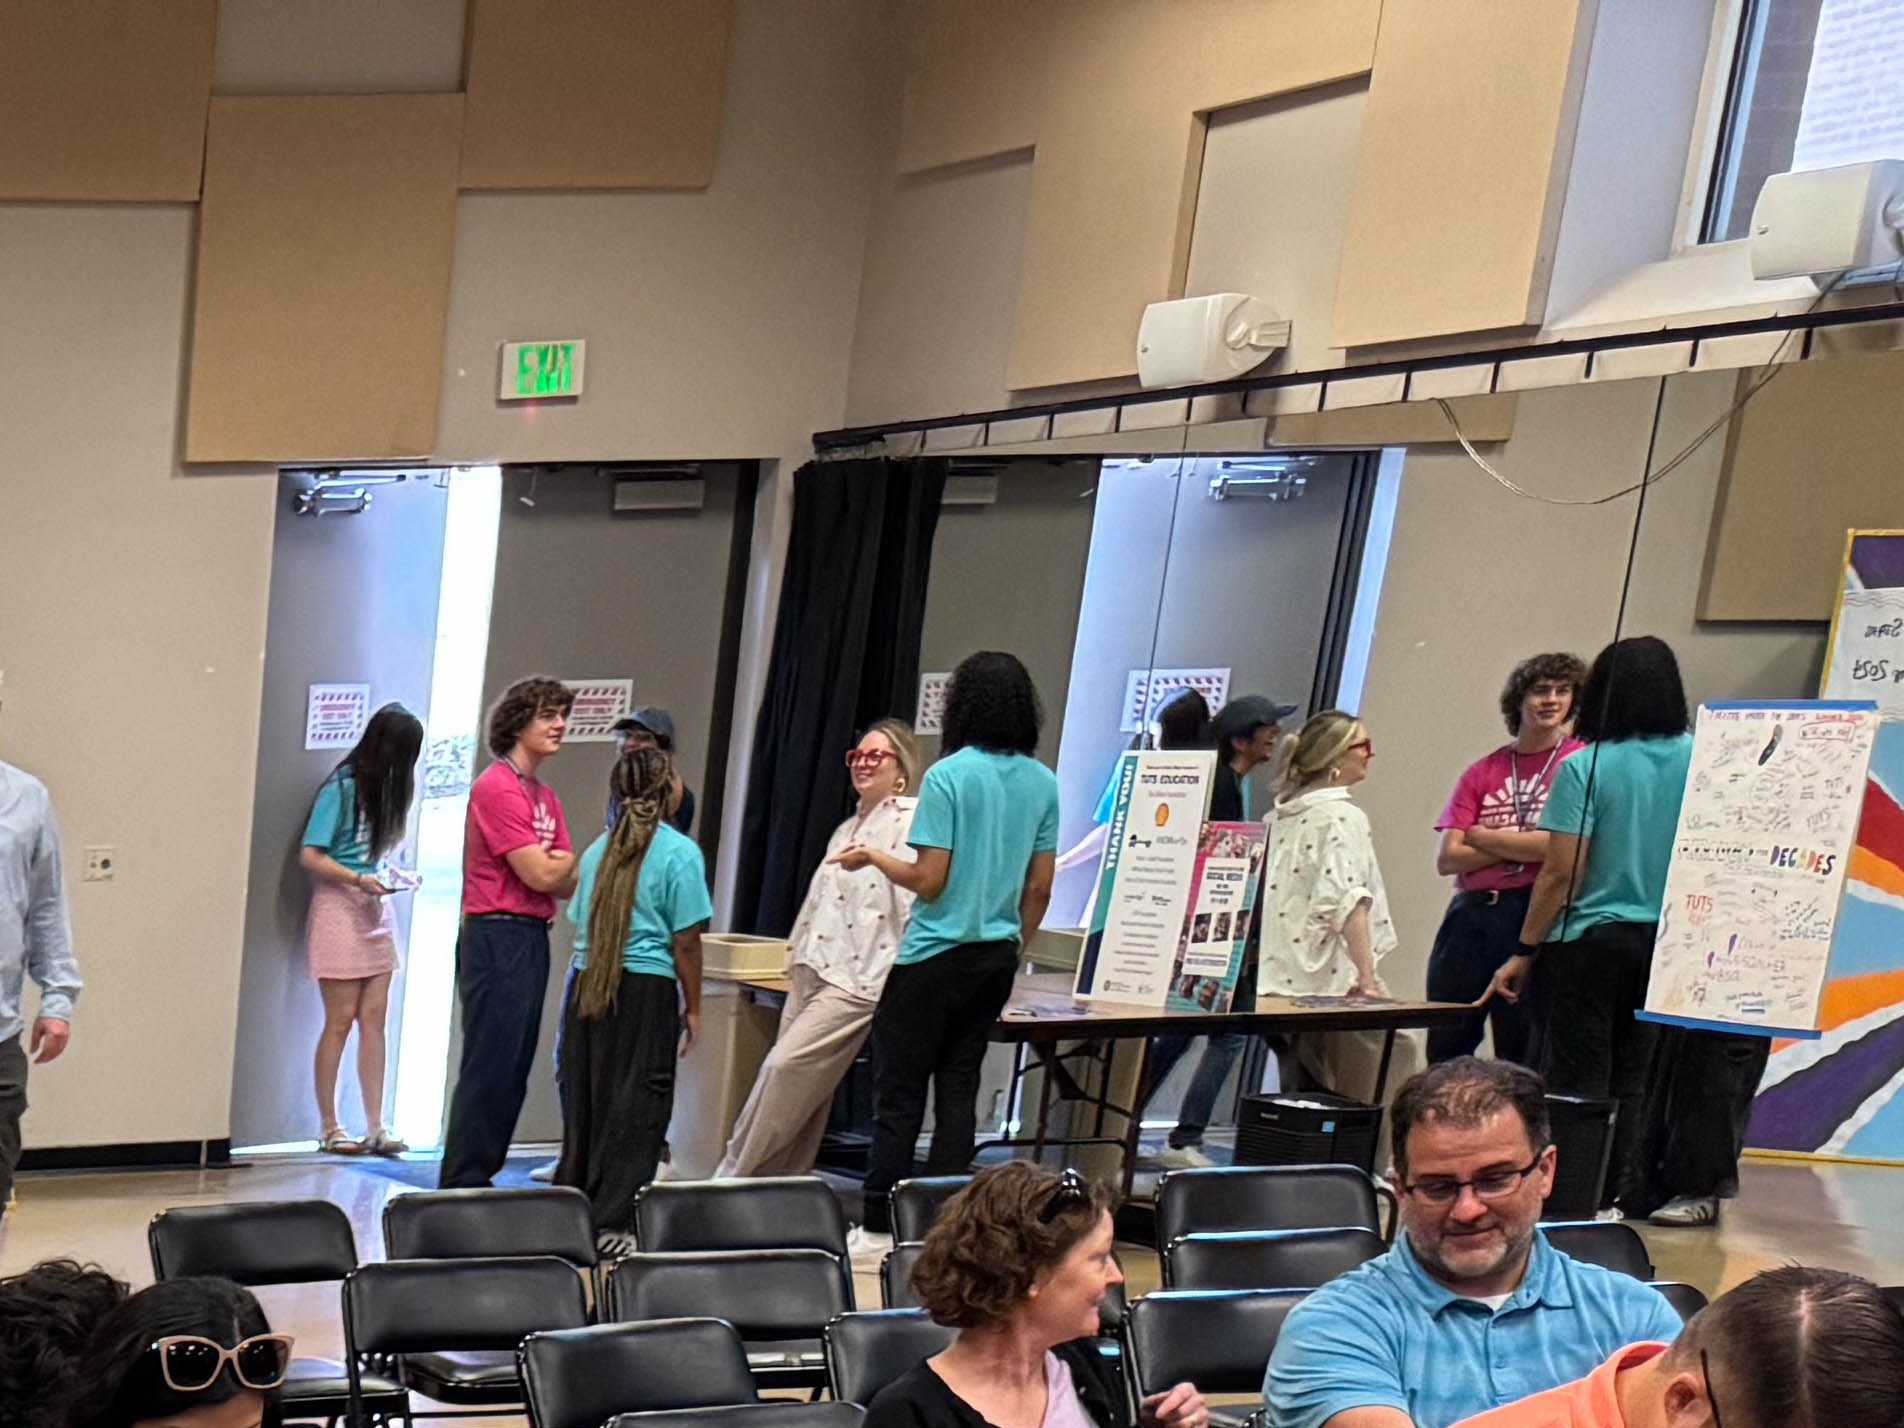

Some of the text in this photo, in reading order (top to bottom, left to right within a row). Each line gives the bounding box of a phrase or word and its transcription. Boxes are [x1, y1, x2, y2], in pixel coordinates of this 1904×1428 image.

[517, 344, 576, 394] EXIT
[1105, 810, 1125, 870] THANK
[1769, 845, 1837, 876] DECADES
[1686, 894, 1713, 913] TUTS
